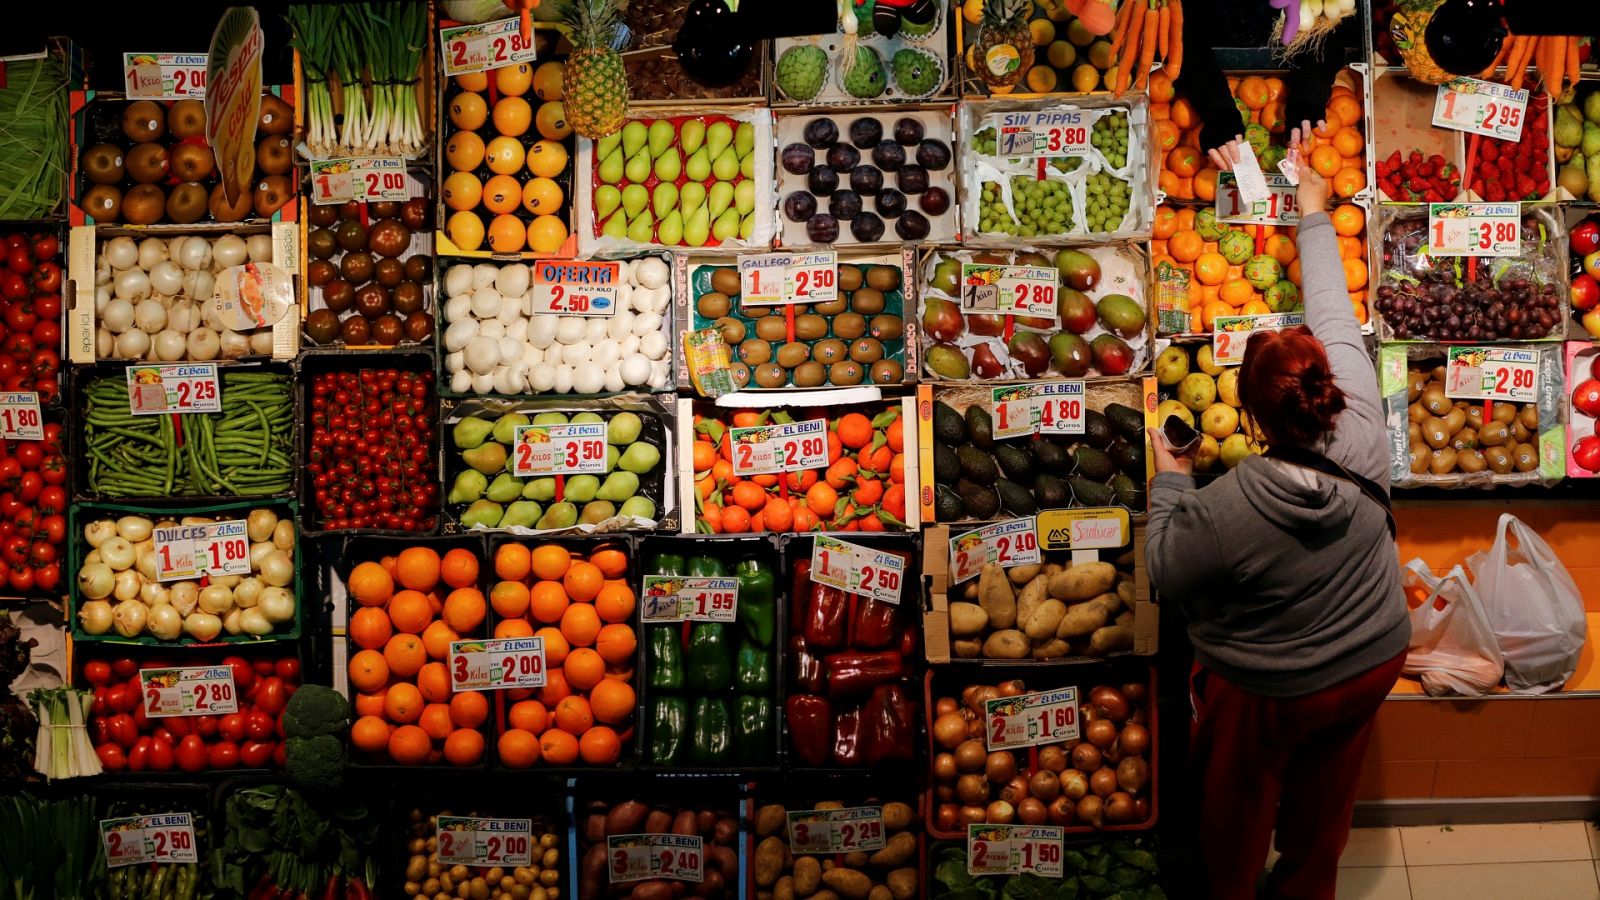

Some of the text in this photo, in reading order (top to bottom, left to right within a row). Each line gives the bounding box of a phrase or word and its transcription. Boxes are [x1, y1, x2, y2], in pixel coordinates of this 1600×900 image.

[175, 56, 185, 64] El
[186, 56, 206, 64] Beni
[452, 41, 470, 67] 2
[127, 69, 138, 90] 1
[1443, 92, 1457, 120] 1
[1490, 86, 1525, 101] EL BENI
[229, 79, 251, 138] Gold
[1482, 102, 1521, 129] 2'95
[1004, 133, 1016, 154] 1
[1048, 127, 1086, 152] 3'80
[374, 160, 400, 170] El Beni
[316, 176, 333, 198] 1
[366, 172, 404, 196] 2'00
[1227, 190, 1241, 215] 1
[1485, 206, 1515, 216] El Beni
[1432, 220, 1445, 248] 1
[1479, 222, 1516, 249] 3'80
[742, 257, 791, 269] GALLEGO
[804, 255, 831, 265] El Beni
[543, 265, 612, 284] OFERTA
[677, 255, 688, 306] blasco
[748, 270, 761, 295] 1
[796, 269, 834, 296] 2'50
[904, 250, 914, 300] blasco
[1027, 269, 1051, 279] El Beni
[965, 285, 977, 308] 1
[1015, 284, 1054, 309] 2'80
[1277, 315, 1302, 325] El Beni
[906, 323, 917, 374] blasco
[1215, 333, 1231, 358] 2
[1502, 351, 1532, 361] El Beni
[177, 366, 209, 375] El Beni
[1450, 366, 1461, 392] 1
[1495, 367, 1534, 393] 2'80
[9, 395, 33, 403] El Beni
[132, 386, 143, 409] 1
[177, 380, 216, 407] 2'25
[1044, 384, 1081, 394] EL BENI
[1, 408, 38, 433] 1'80
[995, 402, 1009, 430] 1
[1041, 399, 1080, 427] 4'80
[568, 426, 599, 436] El Beni
[783, 423, 820, 435] EL BENI
[517, 443, 532, 470] 2
[566, 440, 603, 468] 3'50
[738, 444, 753, 469] 2
[784, 438, 823, 466] 2'80
[157, 527, 207, 543] DULCES
[218, 524, 243, 536] El Beni
[995, 521, 1027, 536] El Beni
[159, 545, 173, 571] 1
[208, 540, 245, 570] 1'80
[997, 532, 1036, 562] 2'40
[818, 550, 831, 576] 1
[874, 553, 900, 567] El Beni
[956, 551, 970, 578] 2
[708, 579, 735, 589] El Beni
[860, 565, 899, 591] 2'50
[648, 597, 658, 617] 1
[696, 592, 734, 616] 1'95
[504, 640, 535, 651] El Beni
[204, 669, 230, 679] El Beni
[453, 656, 488, 683] 3 Kilos
[502, 655, 542, 683] 2'00
[147, 689, 162, 713] 2
[193, 683, 232, 710] 2'80
[1041, 692, 1070, 704] El Beni
[991, 717, 1006, 743] 2
[1038, 706, 1075, 738] 1'60
[151, 816, 187, 826] EL BENI
[490, 821, 527, 830] EL BENI
[107, 832, 123, 858] 2
[153, 831, 191, 857] 2'50
[439, 832, 455, 857] 2
[661, 837, 698, 847] EL BENI
[795, 823, 810, 846] 3
[1031, 829, 1057, 839] El Beni
[487, 835, 527, 861] 2'00
[972, 841, 988, 868] 2
[1021, 842, 1060, 869] 1'50
[613, 850, 629, 875] 3
[660, 849, 699, 874] 2'40
